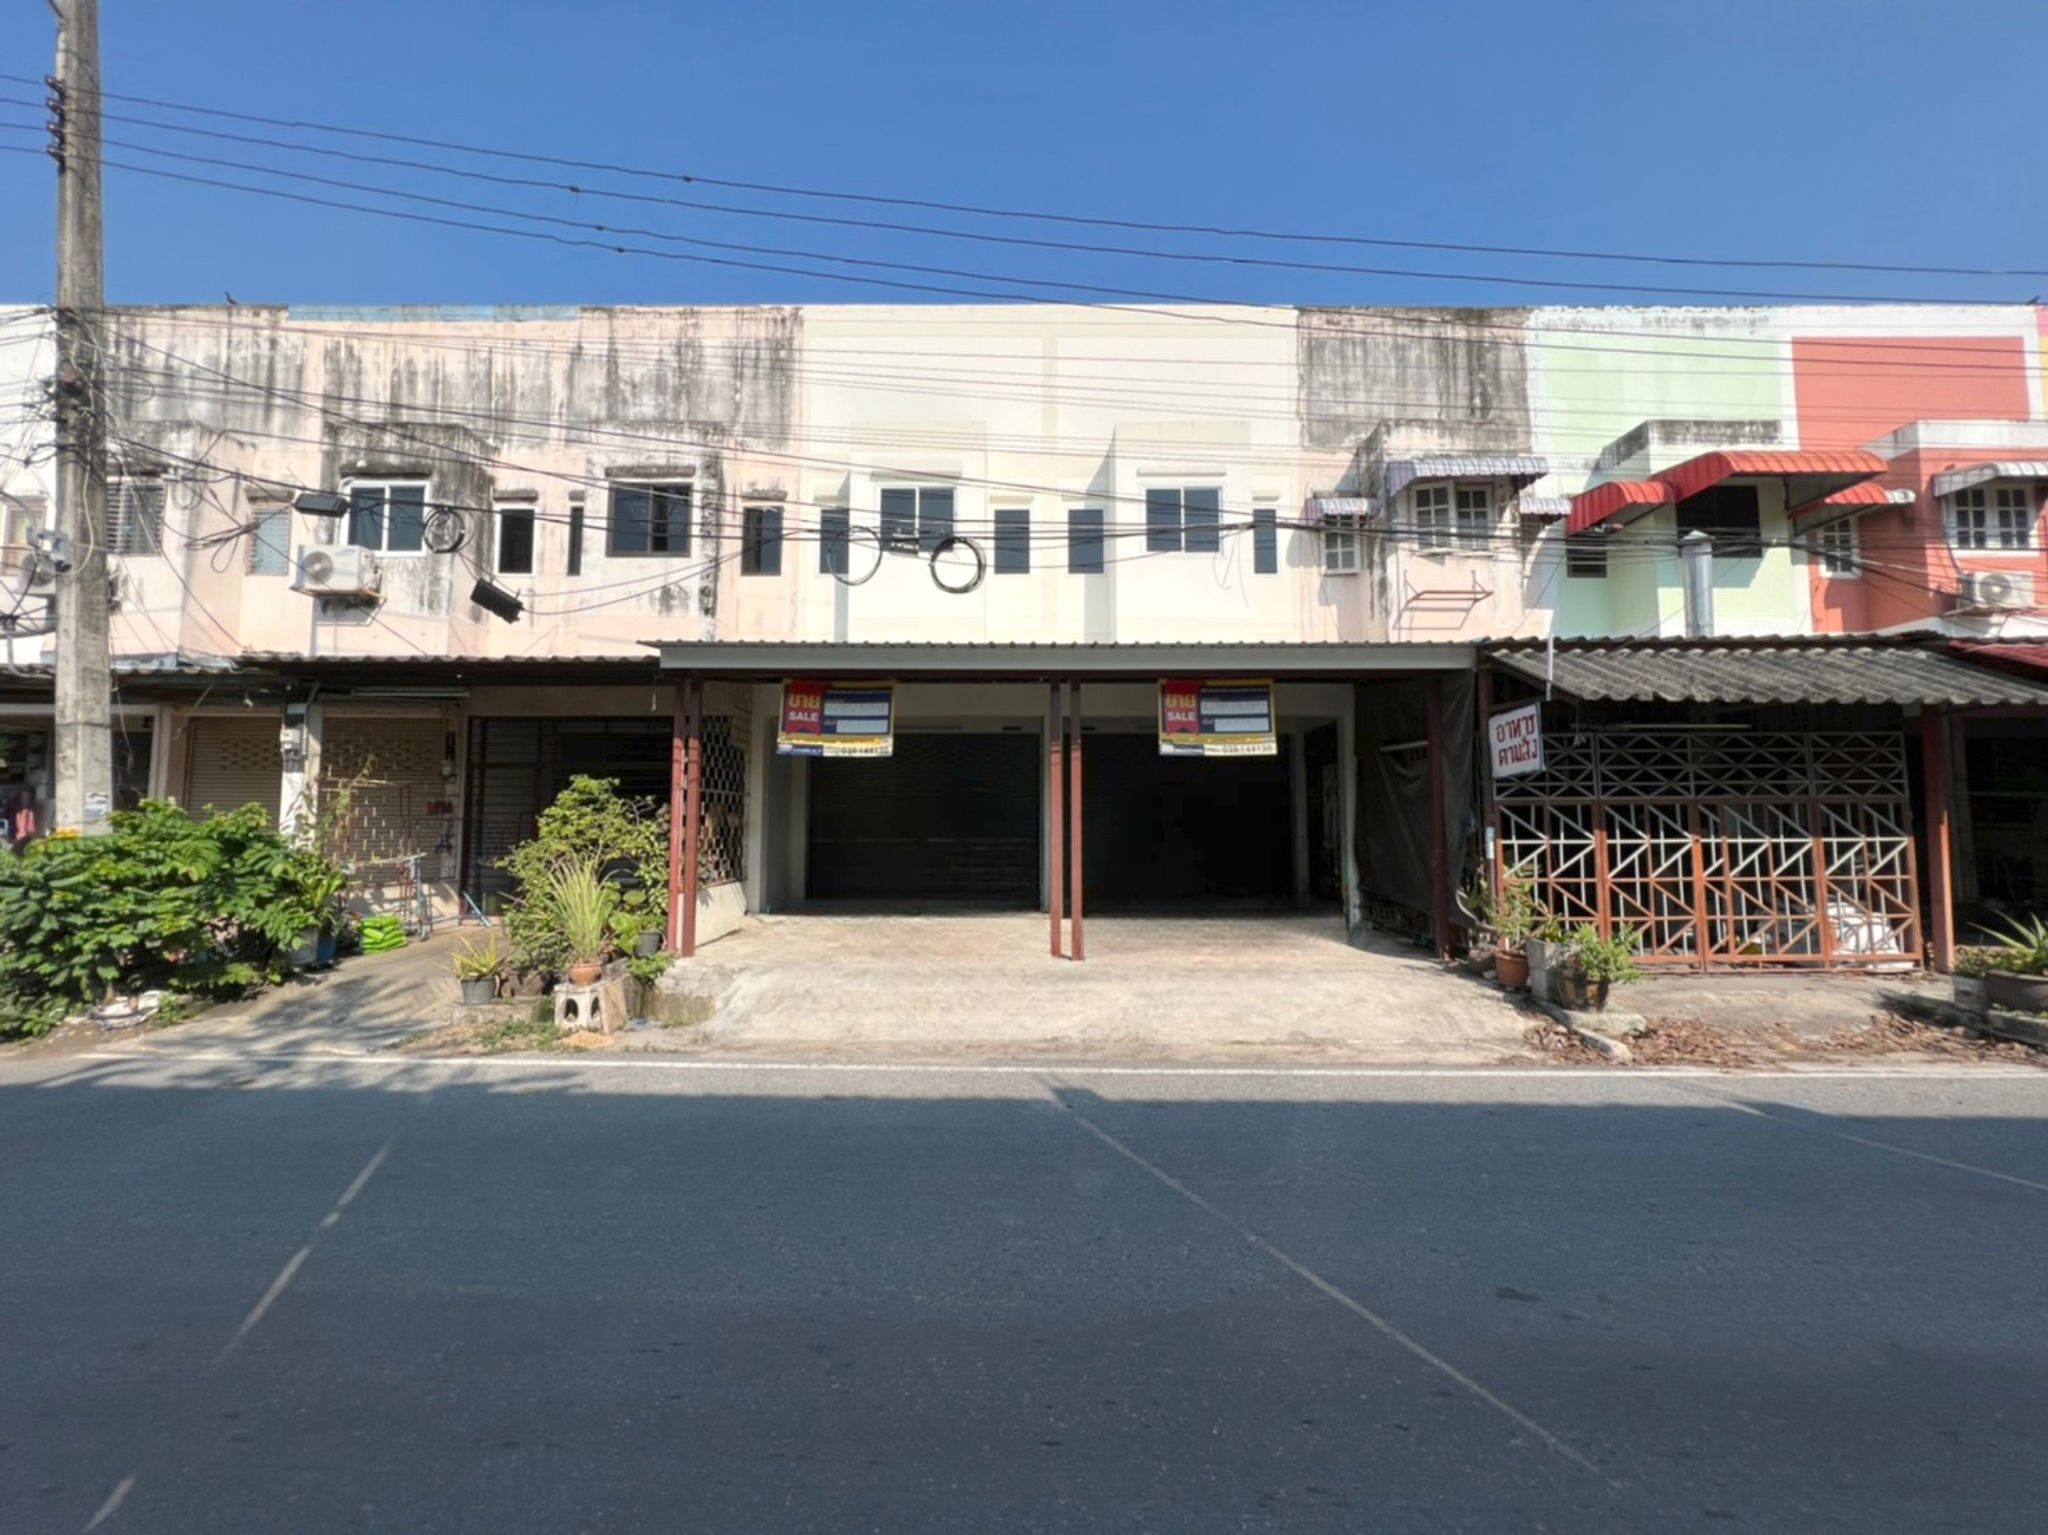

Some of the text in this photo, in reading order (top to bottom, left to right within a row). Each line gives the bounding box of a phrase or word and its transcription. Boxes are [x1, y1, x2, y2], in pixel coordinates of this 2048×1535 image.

[789, 694, 820, 709] ขาย
[1167, 694, 1196, 709] ขาย
[788, 711, 819, 722] SALE
[1167, 711, 1196, 721] SALE
[1496, 714, 1536, 742] อาหาร
